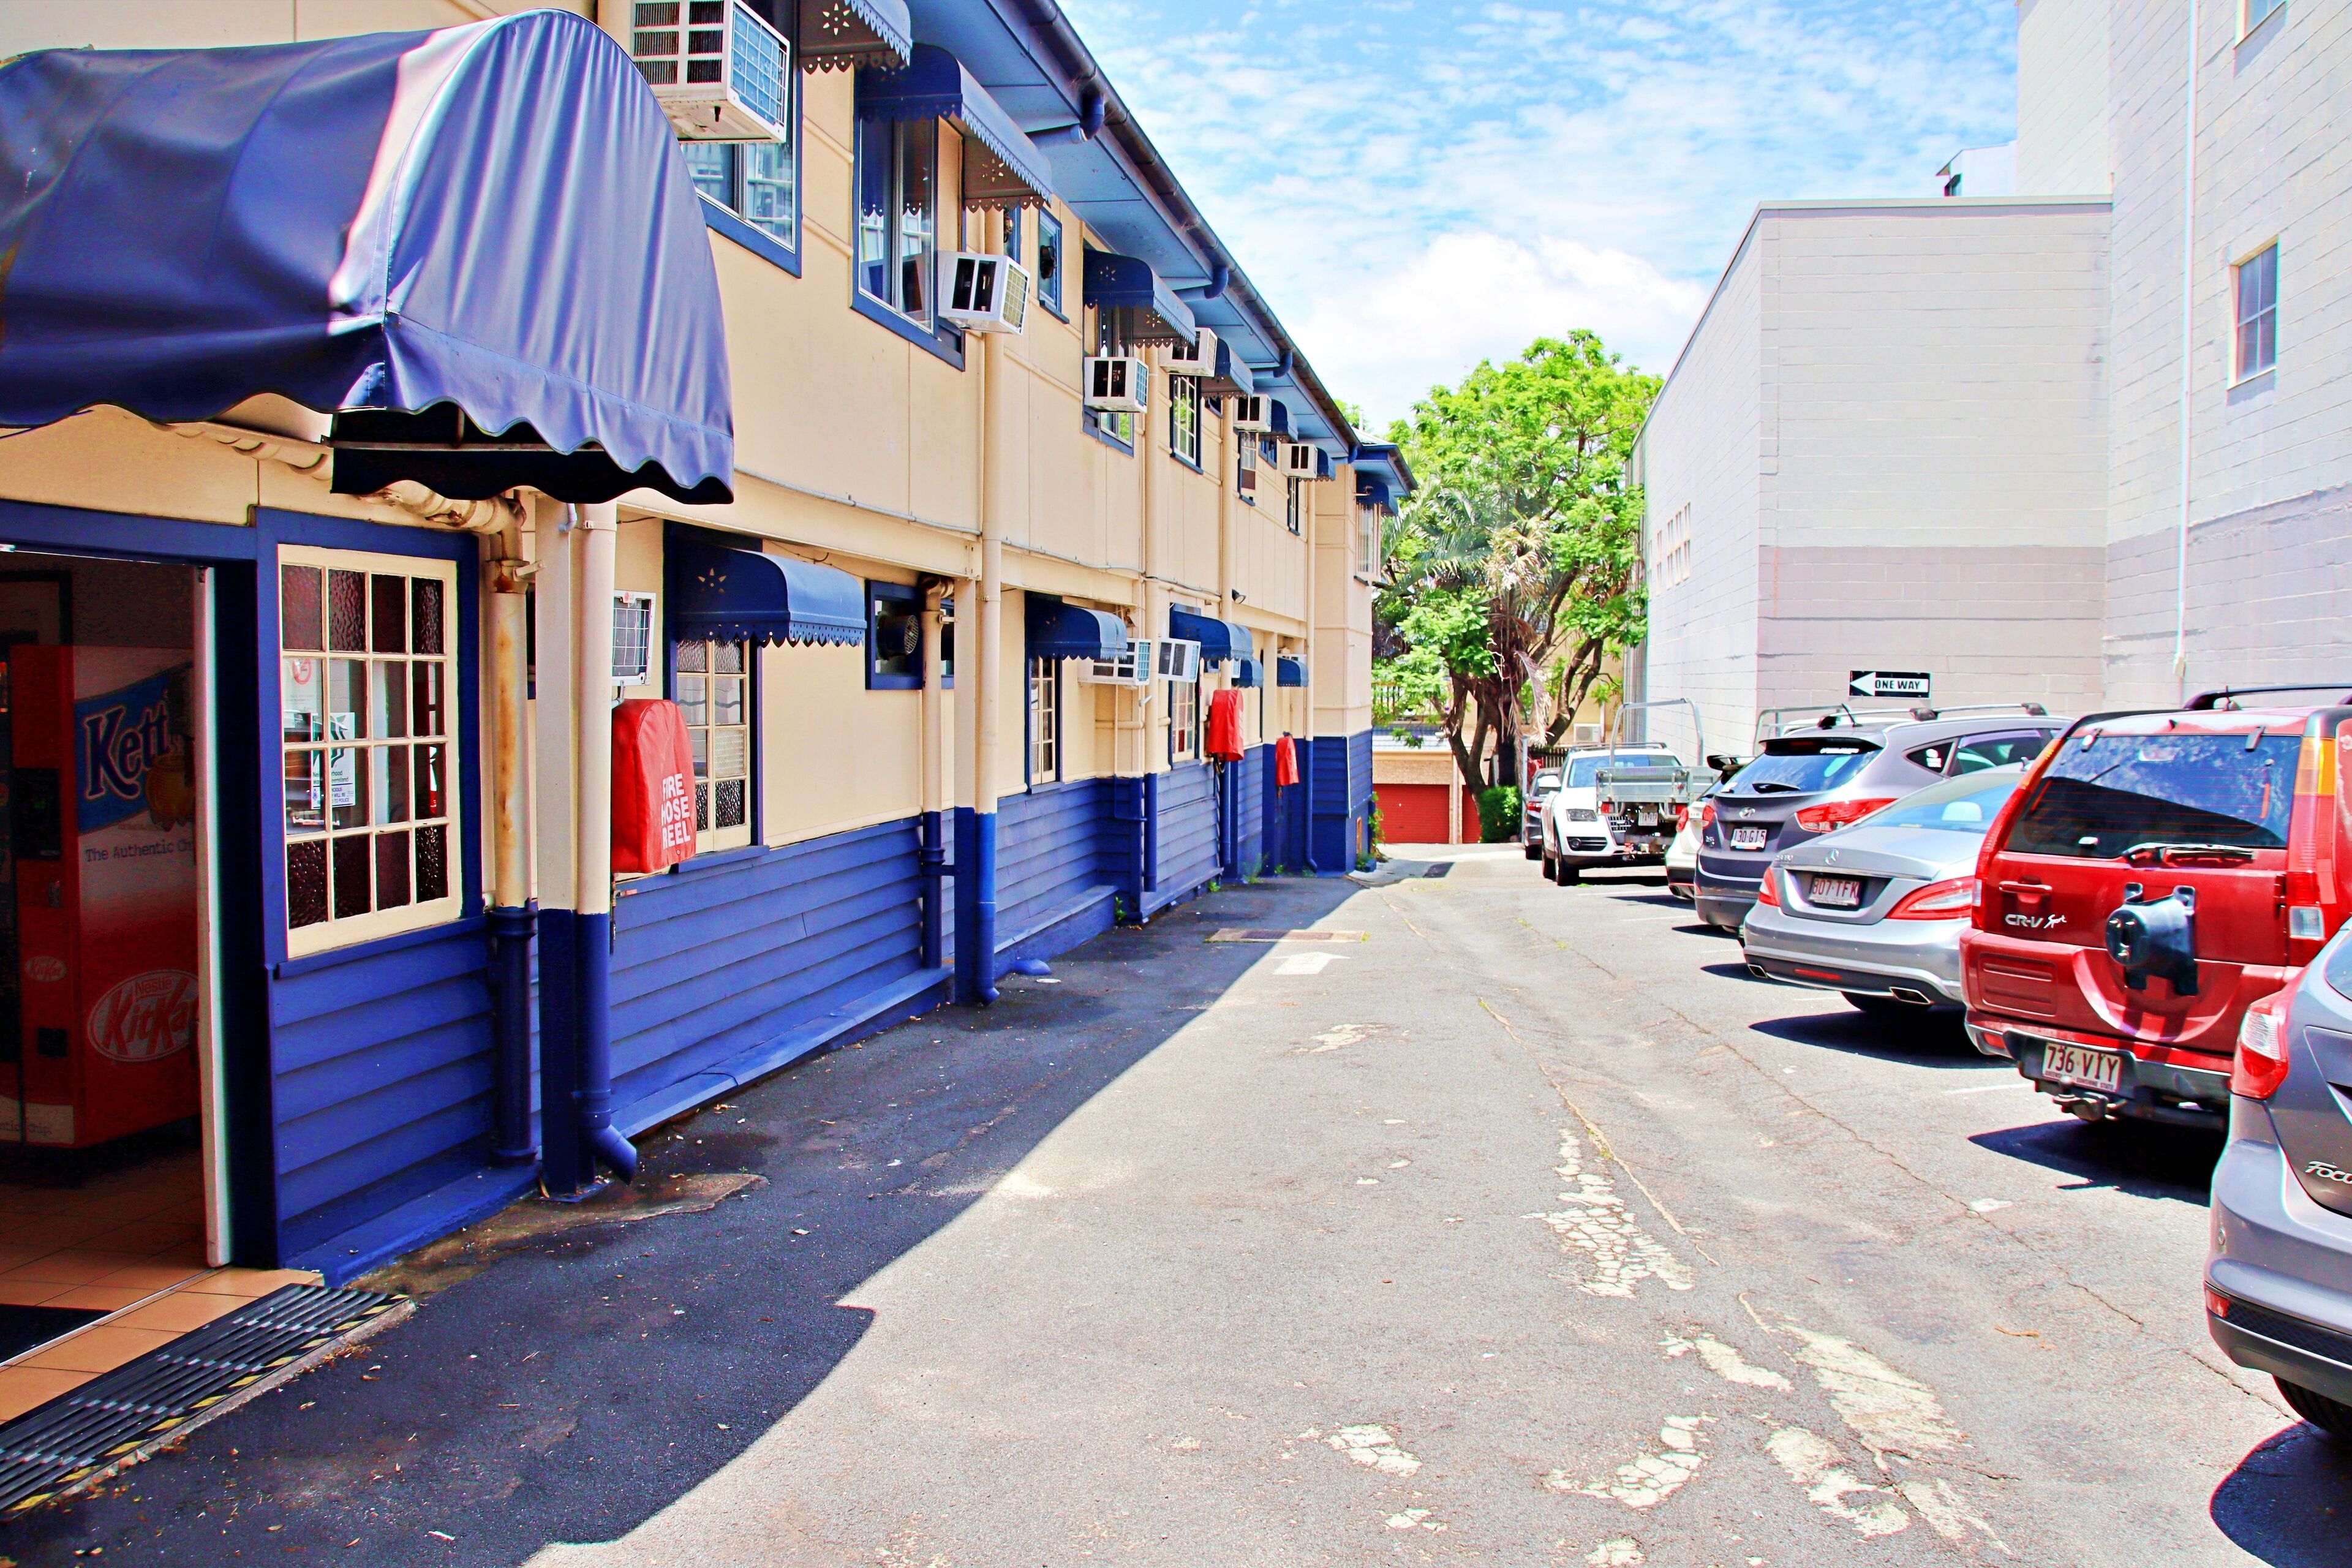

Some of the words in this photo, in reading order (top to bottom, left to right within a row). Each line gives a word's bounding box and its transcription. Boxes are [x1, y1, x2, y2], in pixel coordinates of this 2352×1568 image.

[1875, 680, 1894, 689] ONE
[1898, 680, 1920, 690] WAY
[662, 773, 685, 801] FIRE
[661, 796, 690, 826] HOSE
[662, 820, 691, 850] REEL
[85, 847, 109, 862] The
[113, 839, 174, 859] Authentic
[2005, 914, 2043, 927] CR-V
